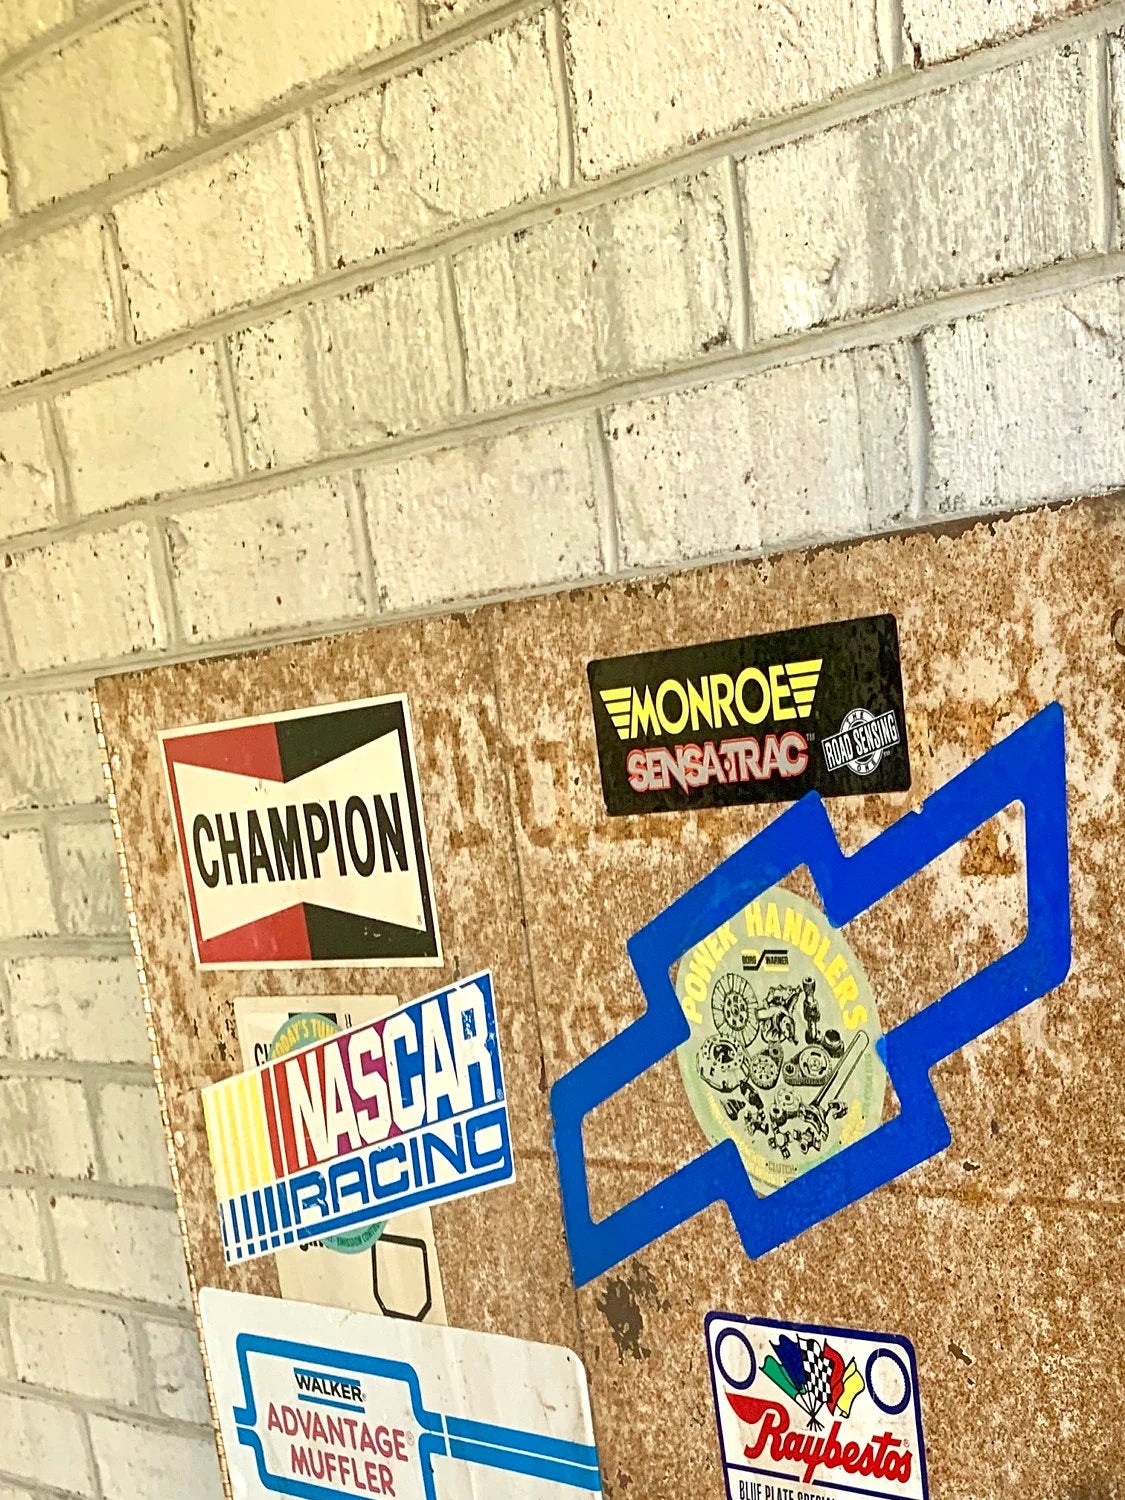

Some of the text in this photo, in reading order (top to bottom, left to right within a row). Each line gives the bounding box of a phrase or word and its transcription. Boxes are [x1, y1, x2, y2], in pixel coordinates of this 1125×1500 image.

[630, 664, 798, 740] MONROE
[824, 713, 898, 768] ROAD SENSING
[192, 792, 408, 888] CHAMPION
[744, 901, 868, 1030] HANDLERS
[285, 982, 497, 1168] NASCAR
[289, 1107, 507, 1224] RACING
[294, 1373, 363, 1402] WALKER
[268, 1402, 409, 1462] ADVANTAGE
[291, 1444, 396, 1497] MUFFLER
[725, 1393, 913, 1484] Raybestos
